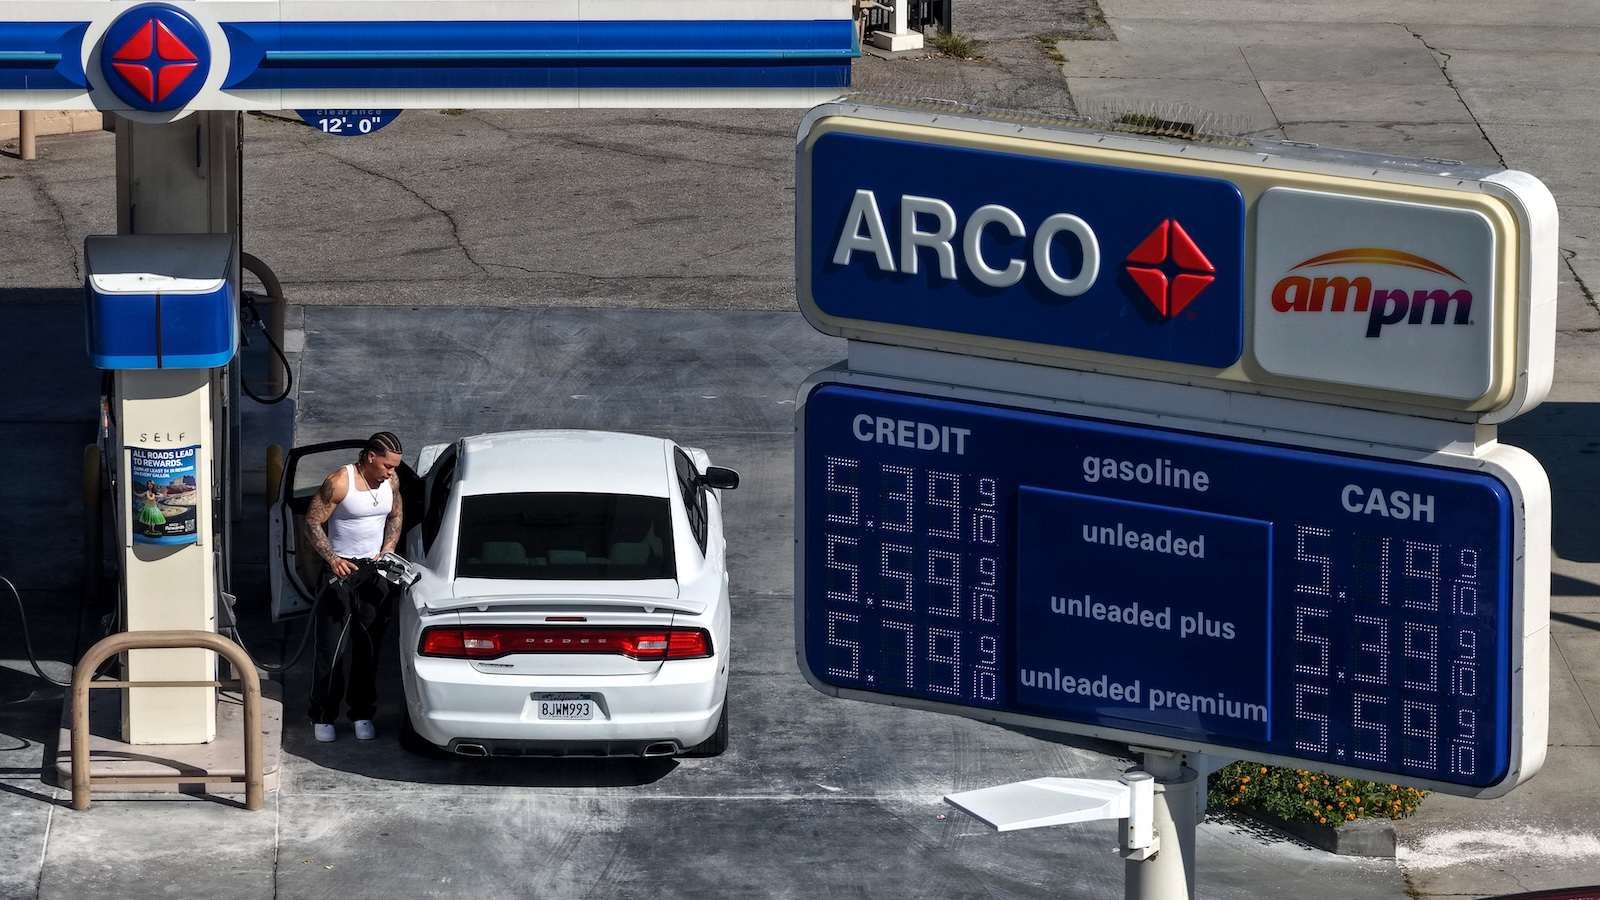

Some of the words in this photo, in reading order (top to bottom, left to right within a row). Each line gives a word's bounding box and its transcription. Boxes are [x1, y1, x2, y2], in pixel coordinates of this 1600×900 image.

[832, 188, 1101, 297] ARCO
[1271, 276, 1474, 338] ampm
[133, 449, 147, 459] ALL
[147, 451, 174, 460] ROADS
[175, 448, 194, 459] LEAD
[140, 432, 185, 443] SELF
[852, 413, 971, 455] CREDIT
[134, 457, 142, 466] TO
[143, 458, 183, 468] REWARDS.
[1082, 455, 1209, 492] gasoline
[827, 456, 960, 539] 5.39
[1341, 484, 1435, 523] CASH
[1082, 522, 1205, 559] unleaded
[827, 534, 960, 618] 5.59
[1297, 525, 1439, 612] 5.19
[1050, 595, 1171, 631] unleaded
[1179, 611, 1236, 640] plus
[827, 611, 960, 696] 5.79
[1296, 606, 1438, 692] 5.39
[541, 702, 591, 716] 8JWM993
[1020, 667, 1141, 704] unleaded
[1149, 687, 1268, 723] premium
[1295, 683, 1437, 770] 5.59
